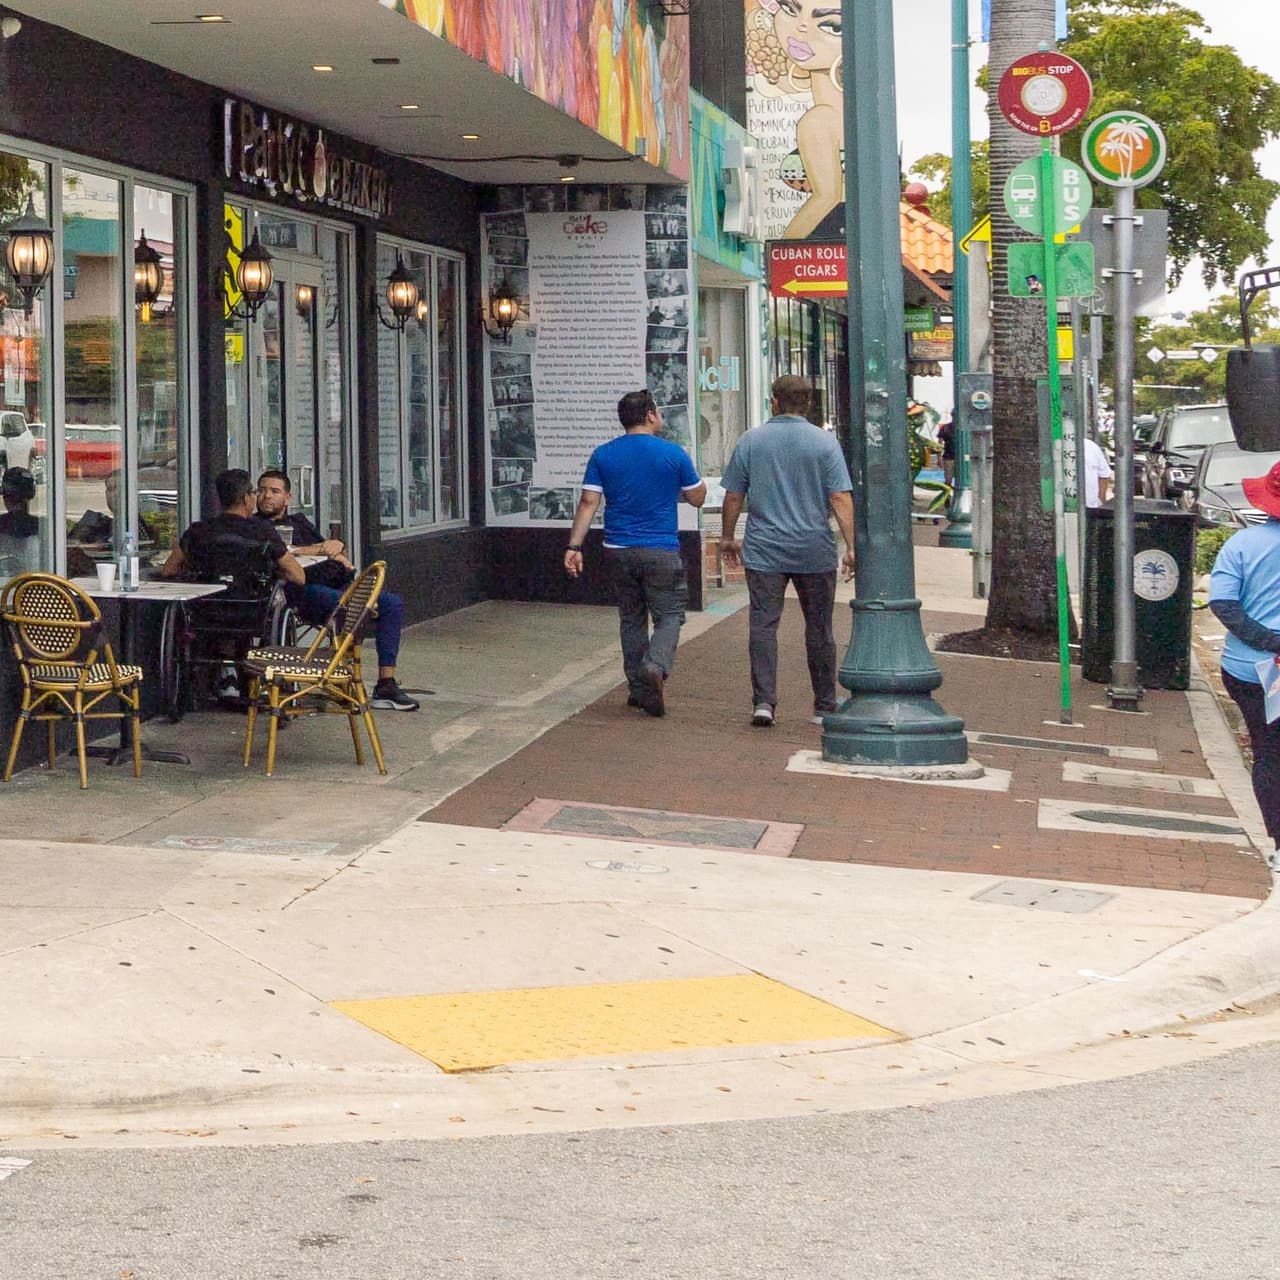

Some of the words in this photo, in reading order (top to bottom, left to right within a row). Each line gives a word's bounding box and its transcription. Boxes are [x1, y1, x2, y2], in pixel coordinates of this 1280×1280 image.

[1047, 65, 1074, 75] STOP
[1062, 169, 1081, 221] BUS
[771, 247, 812, 261] CUBAN
[794, 264, 838, 277] CIGARS
